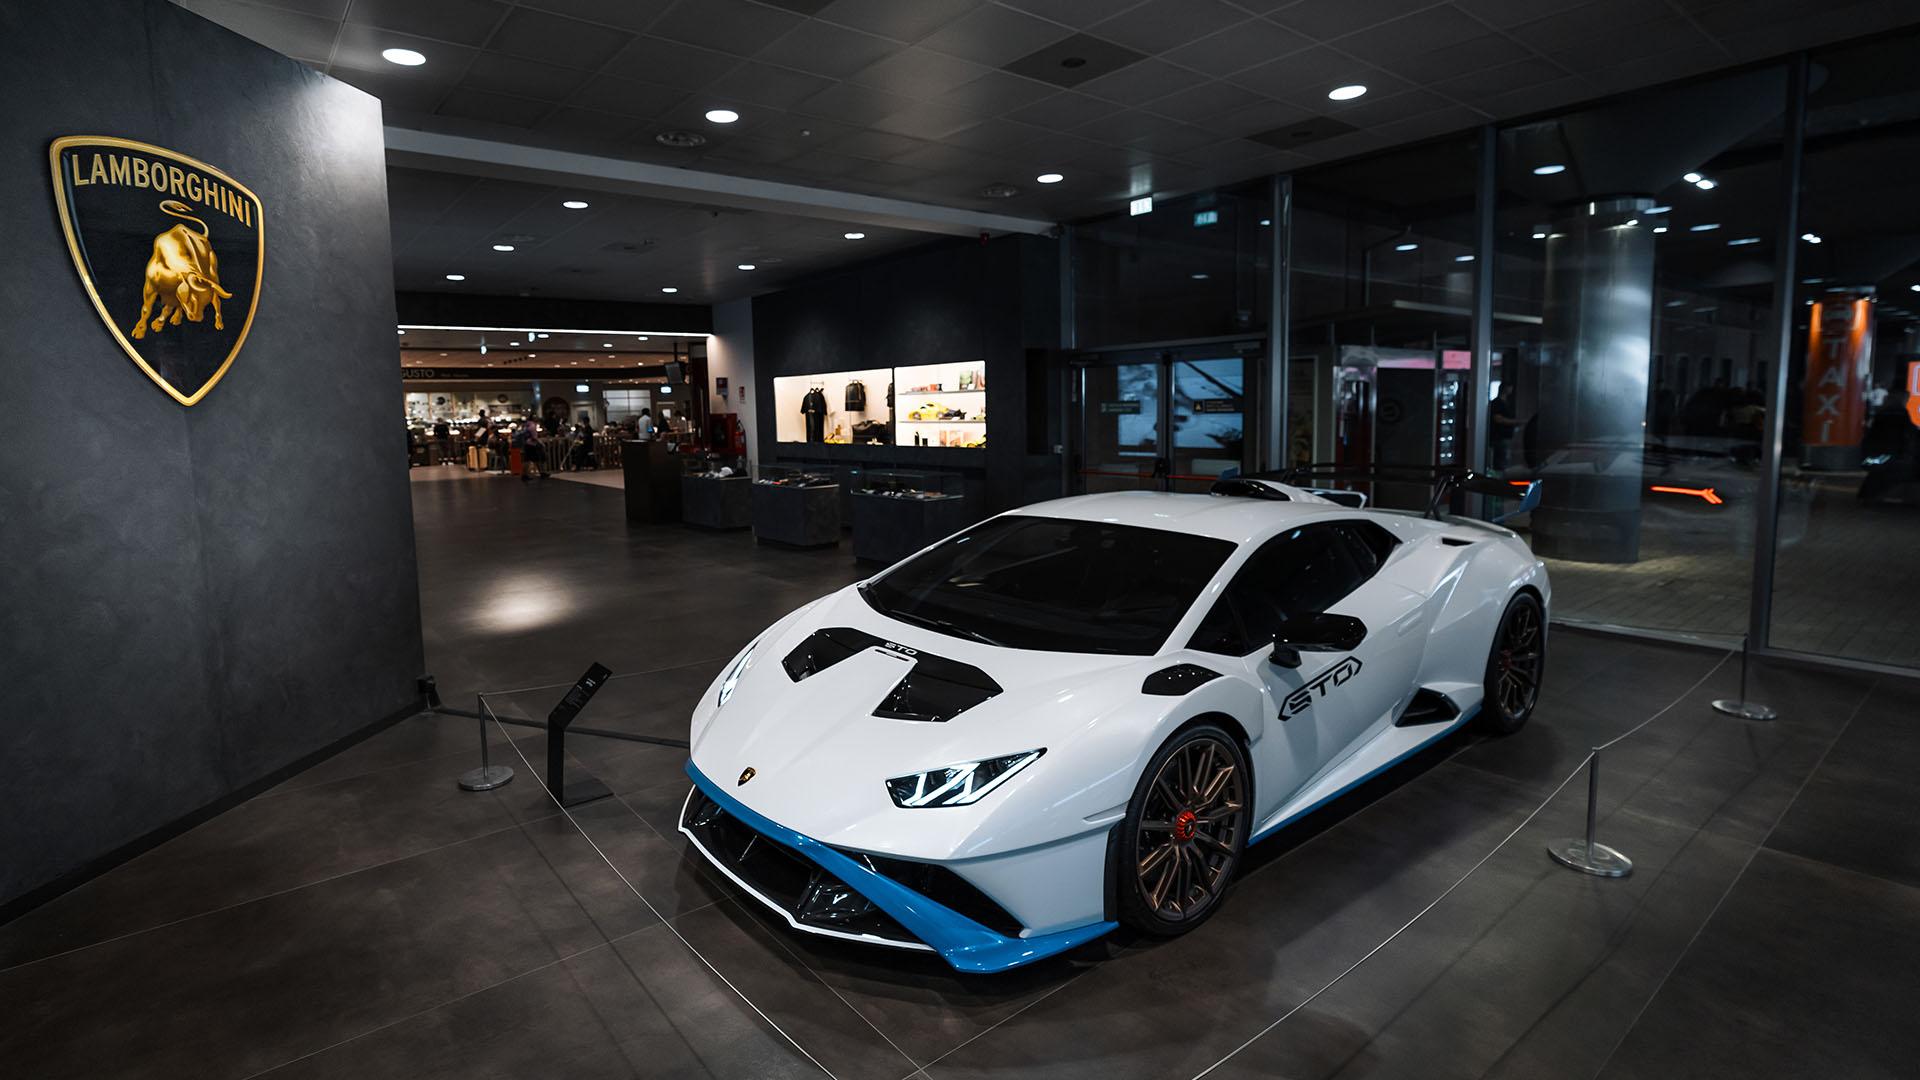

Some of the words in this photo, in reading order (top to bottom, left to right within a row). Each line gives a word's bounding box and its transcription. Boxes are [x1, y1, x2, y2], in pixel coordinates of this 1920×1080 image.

[72, 153, 252, 228] LAMBORGHINI
[884, 642, 918, 656] STO
[1286, 661, 1356, 717] STO
